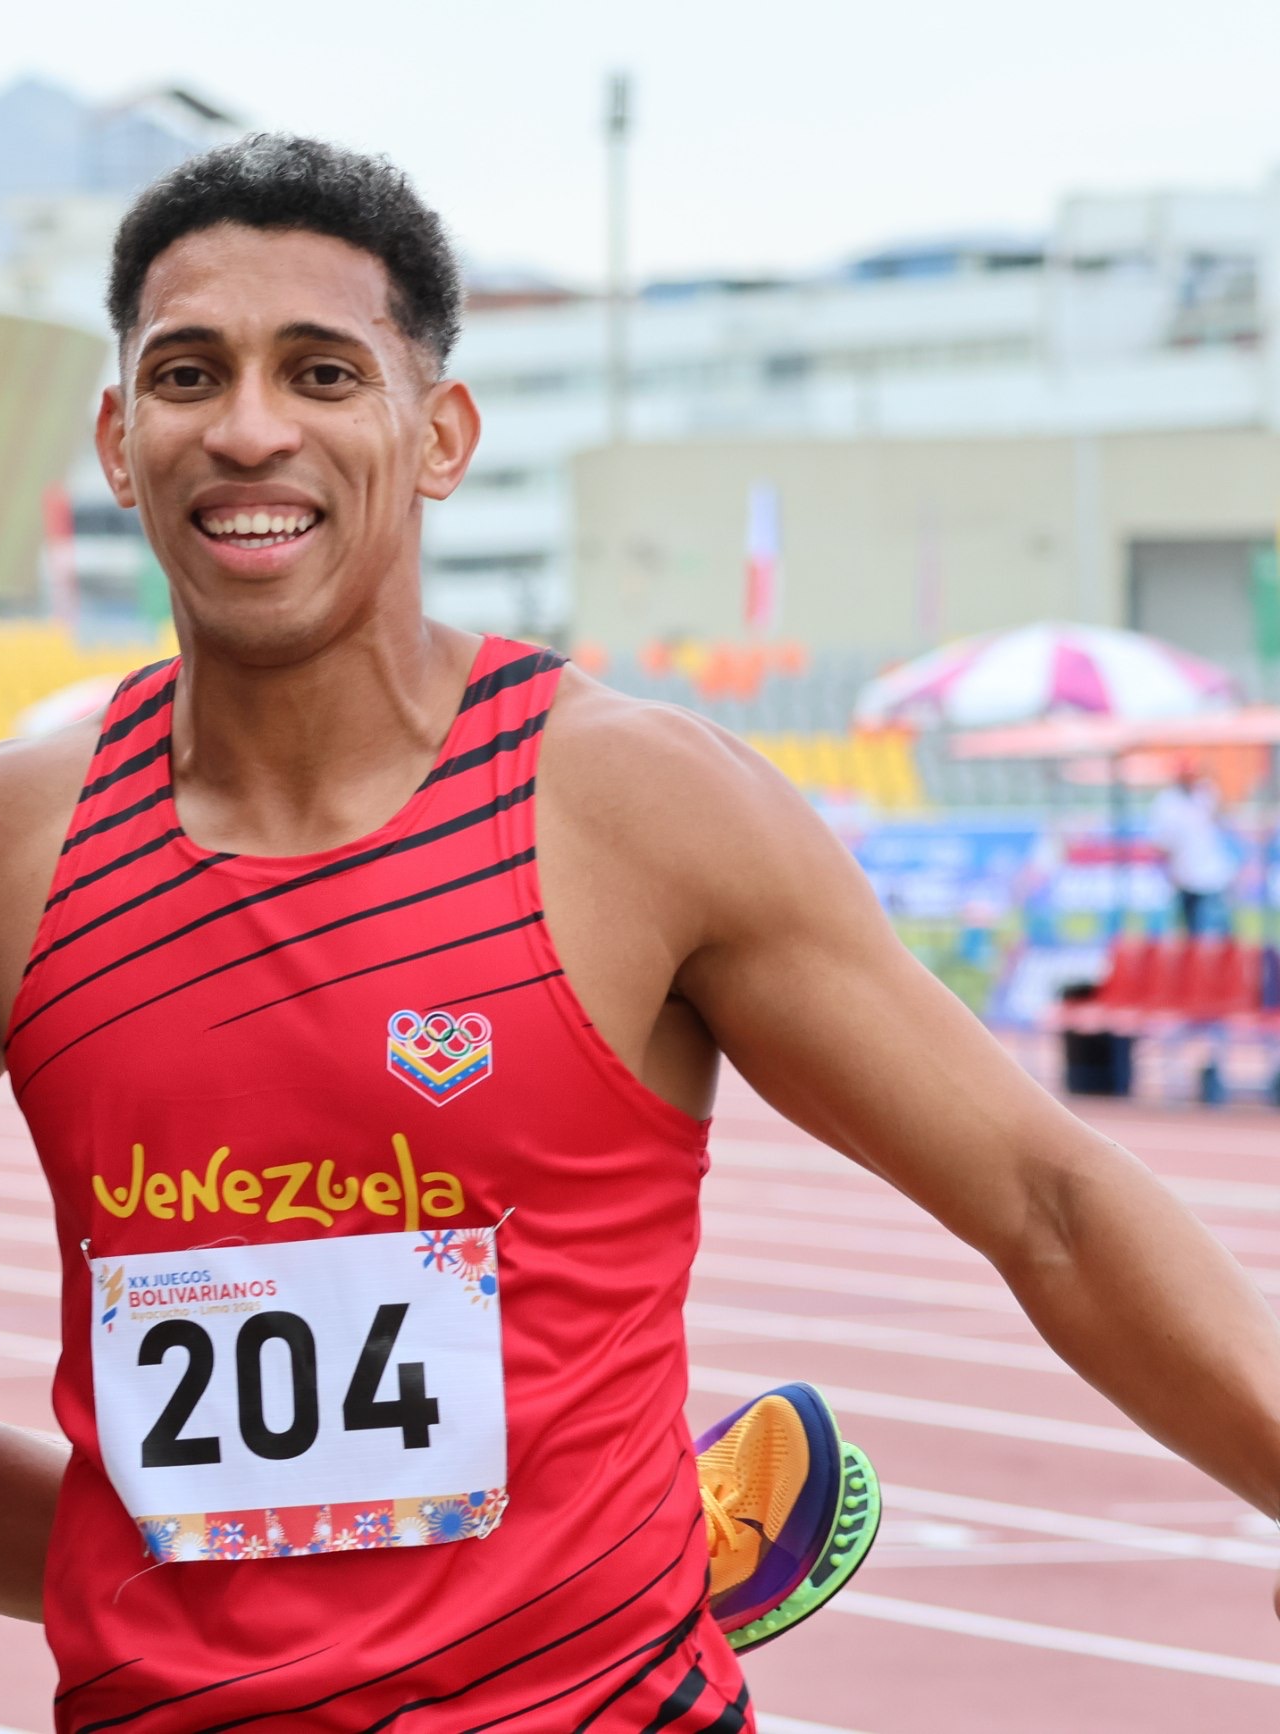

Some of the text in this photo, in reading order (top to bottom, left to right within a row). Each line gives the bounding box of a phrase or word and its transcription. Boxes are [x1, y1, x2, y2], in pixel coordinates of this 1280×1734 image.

[128, 1270, 212, 1288] XX JUEGOS
[128, 1279, 278, 1308] BOLIVARIANOS
[137, 1302, 440, 1468] 204
